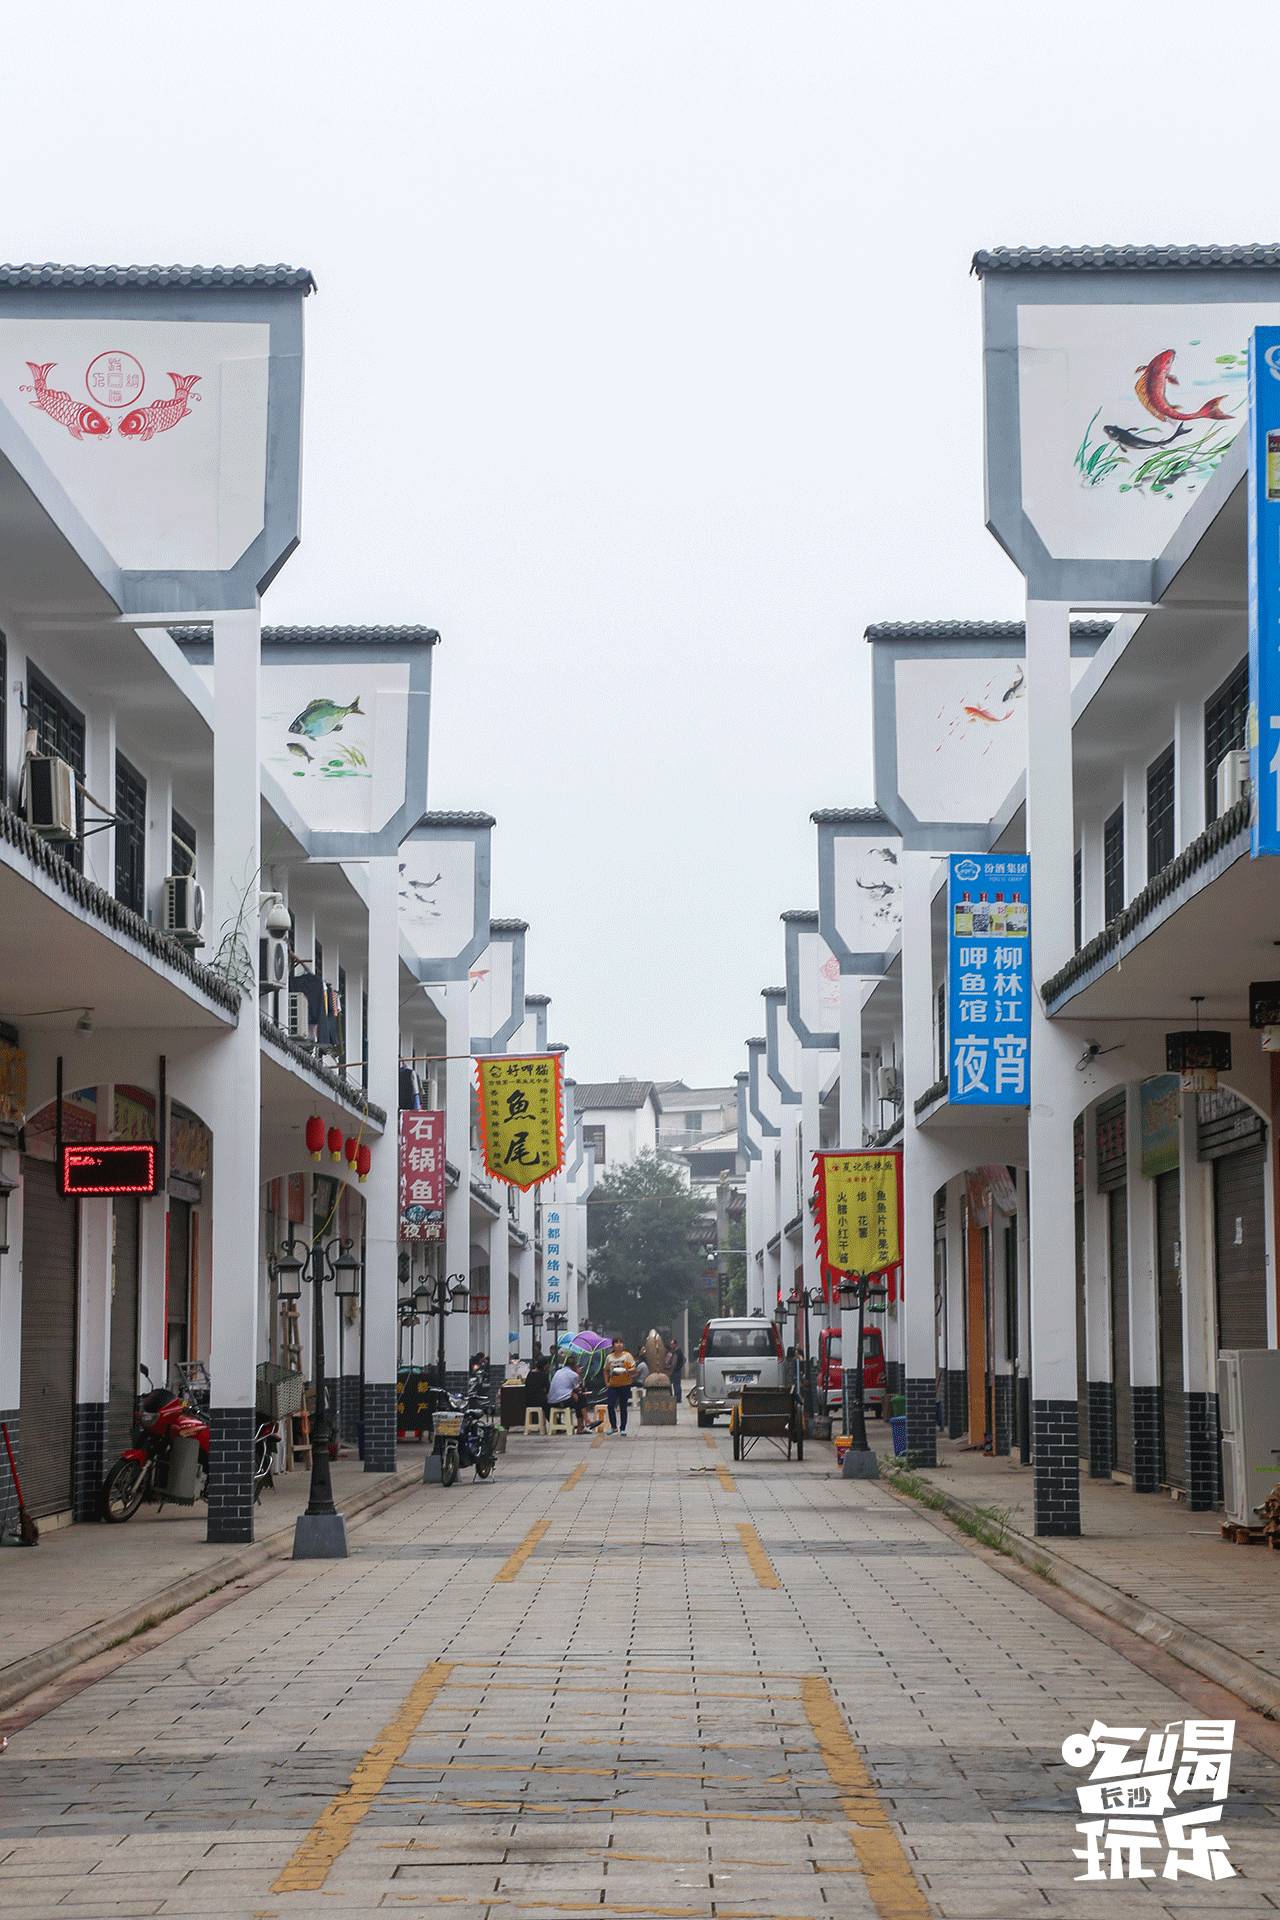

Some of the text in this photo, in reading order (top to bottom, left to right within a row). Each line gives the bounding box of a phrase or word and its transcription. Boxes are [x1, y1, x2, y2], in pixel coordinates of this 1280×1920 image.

[959, 947, 988, 1023] 呷鱼馆
[993, 947, 1023, 1023] 柳林江
[954, 1034, 1027, 1094] 夜宵
[409, 1116, 436, 1204] 石锅鱼
[503, 1089, 540, 1166] 魚尾
[403, 1222, 442, 1239] 夜宵
[547, 1212, 561, 1304] 渔都网络会所
